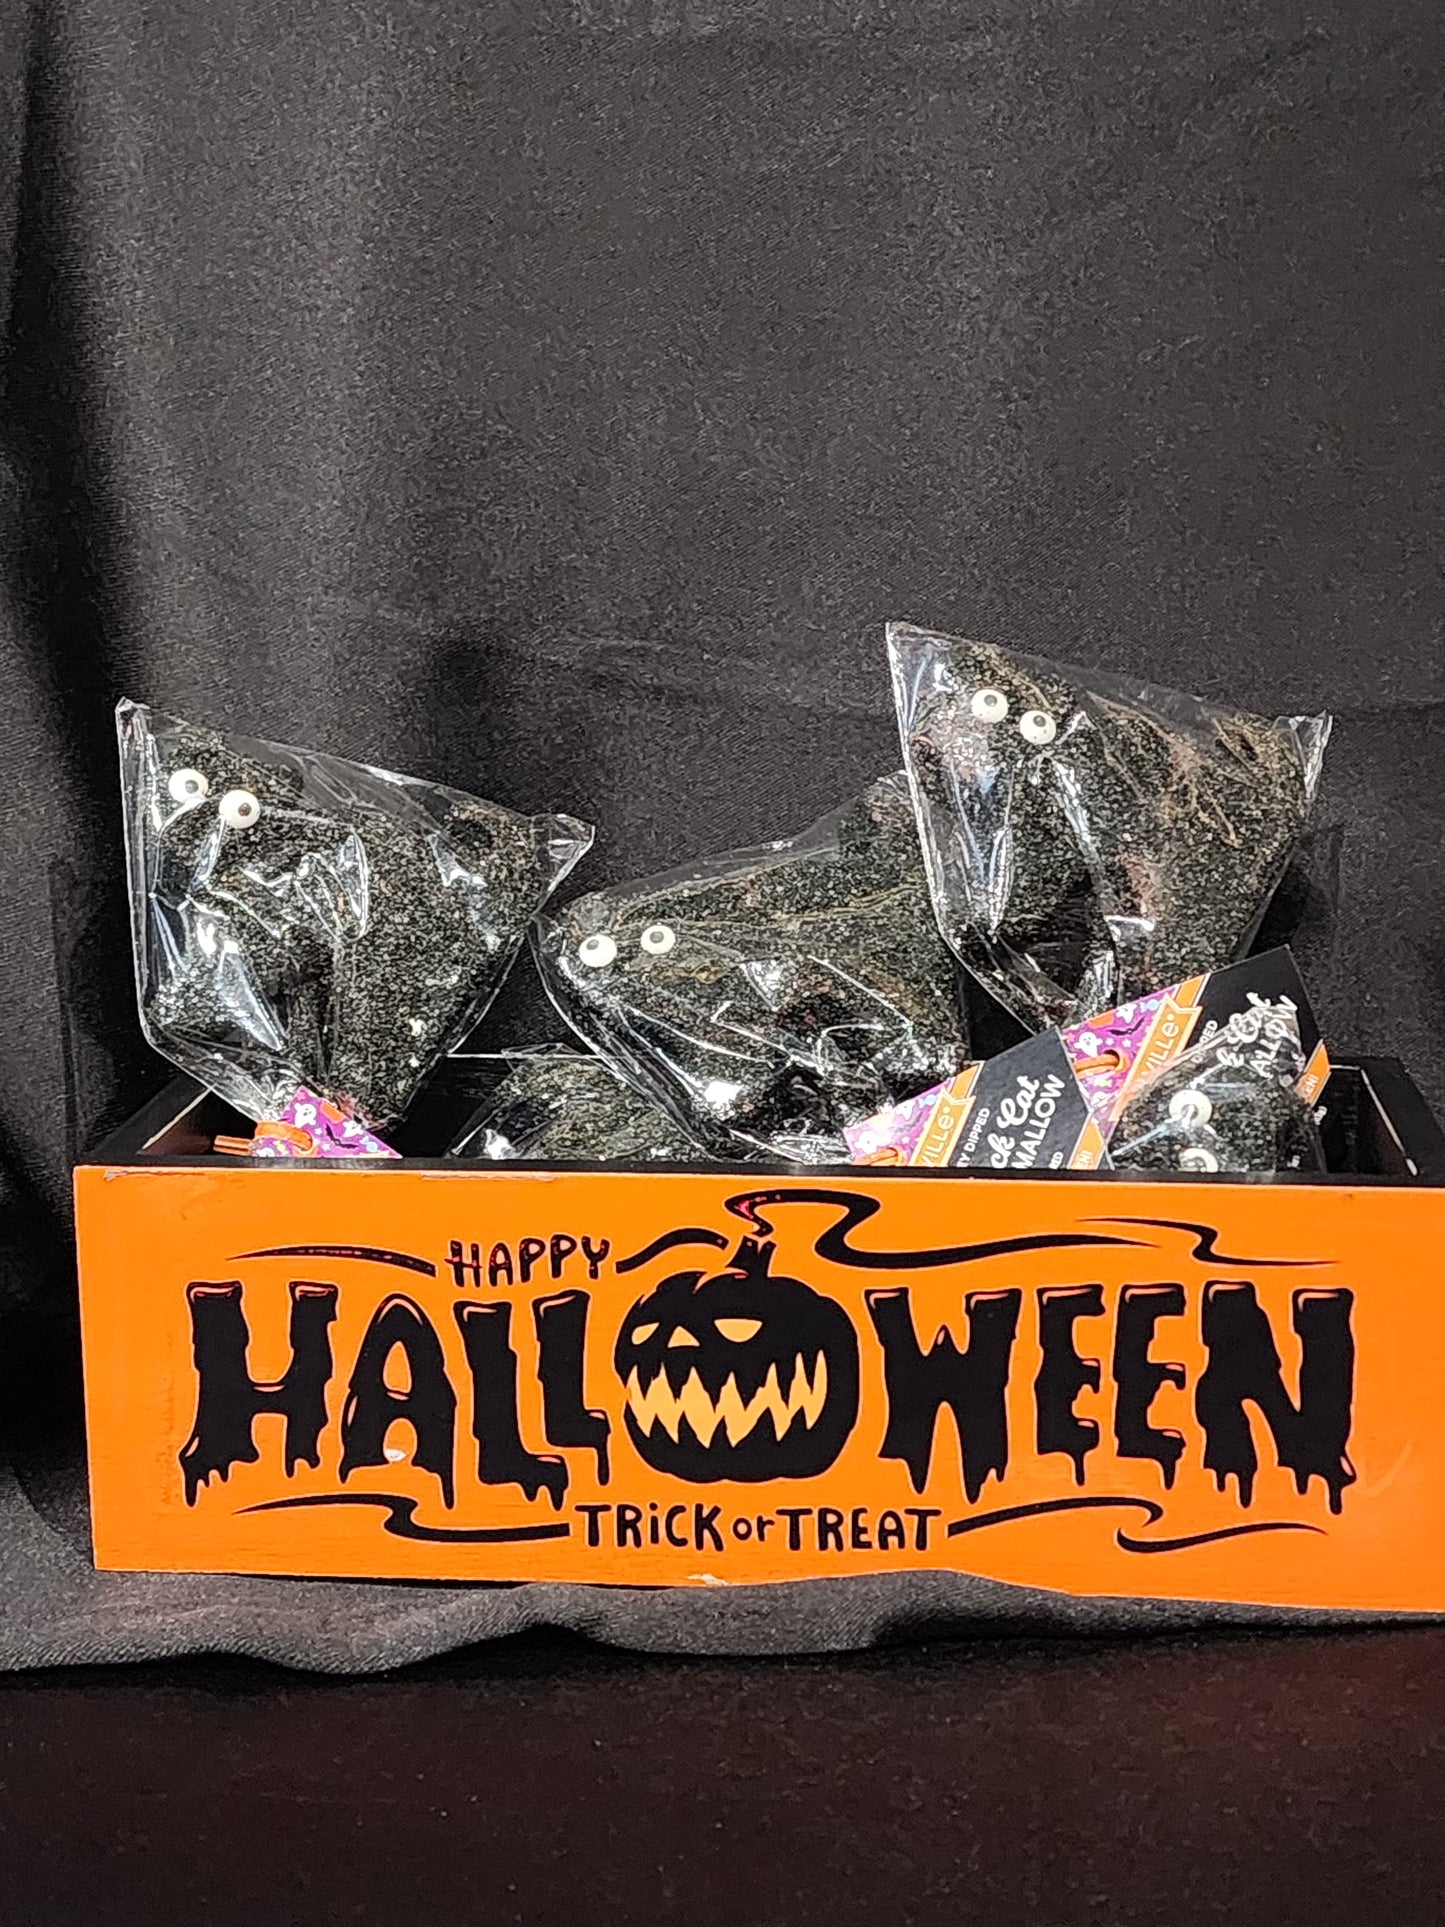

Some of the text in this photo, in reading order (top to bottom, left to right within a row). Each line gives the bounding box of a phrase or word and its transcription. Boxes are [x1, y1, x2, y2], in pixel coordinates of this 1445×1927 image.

[963, 1107, 990, 1152] DIPPED
[444, 1234, 610, 1288] HAPPY
[179, 1268, 1357, 1515] HALLOWEEN
[732, 1515, 775, 1542] or
[775, 1507, 942, 1551] TREAT
